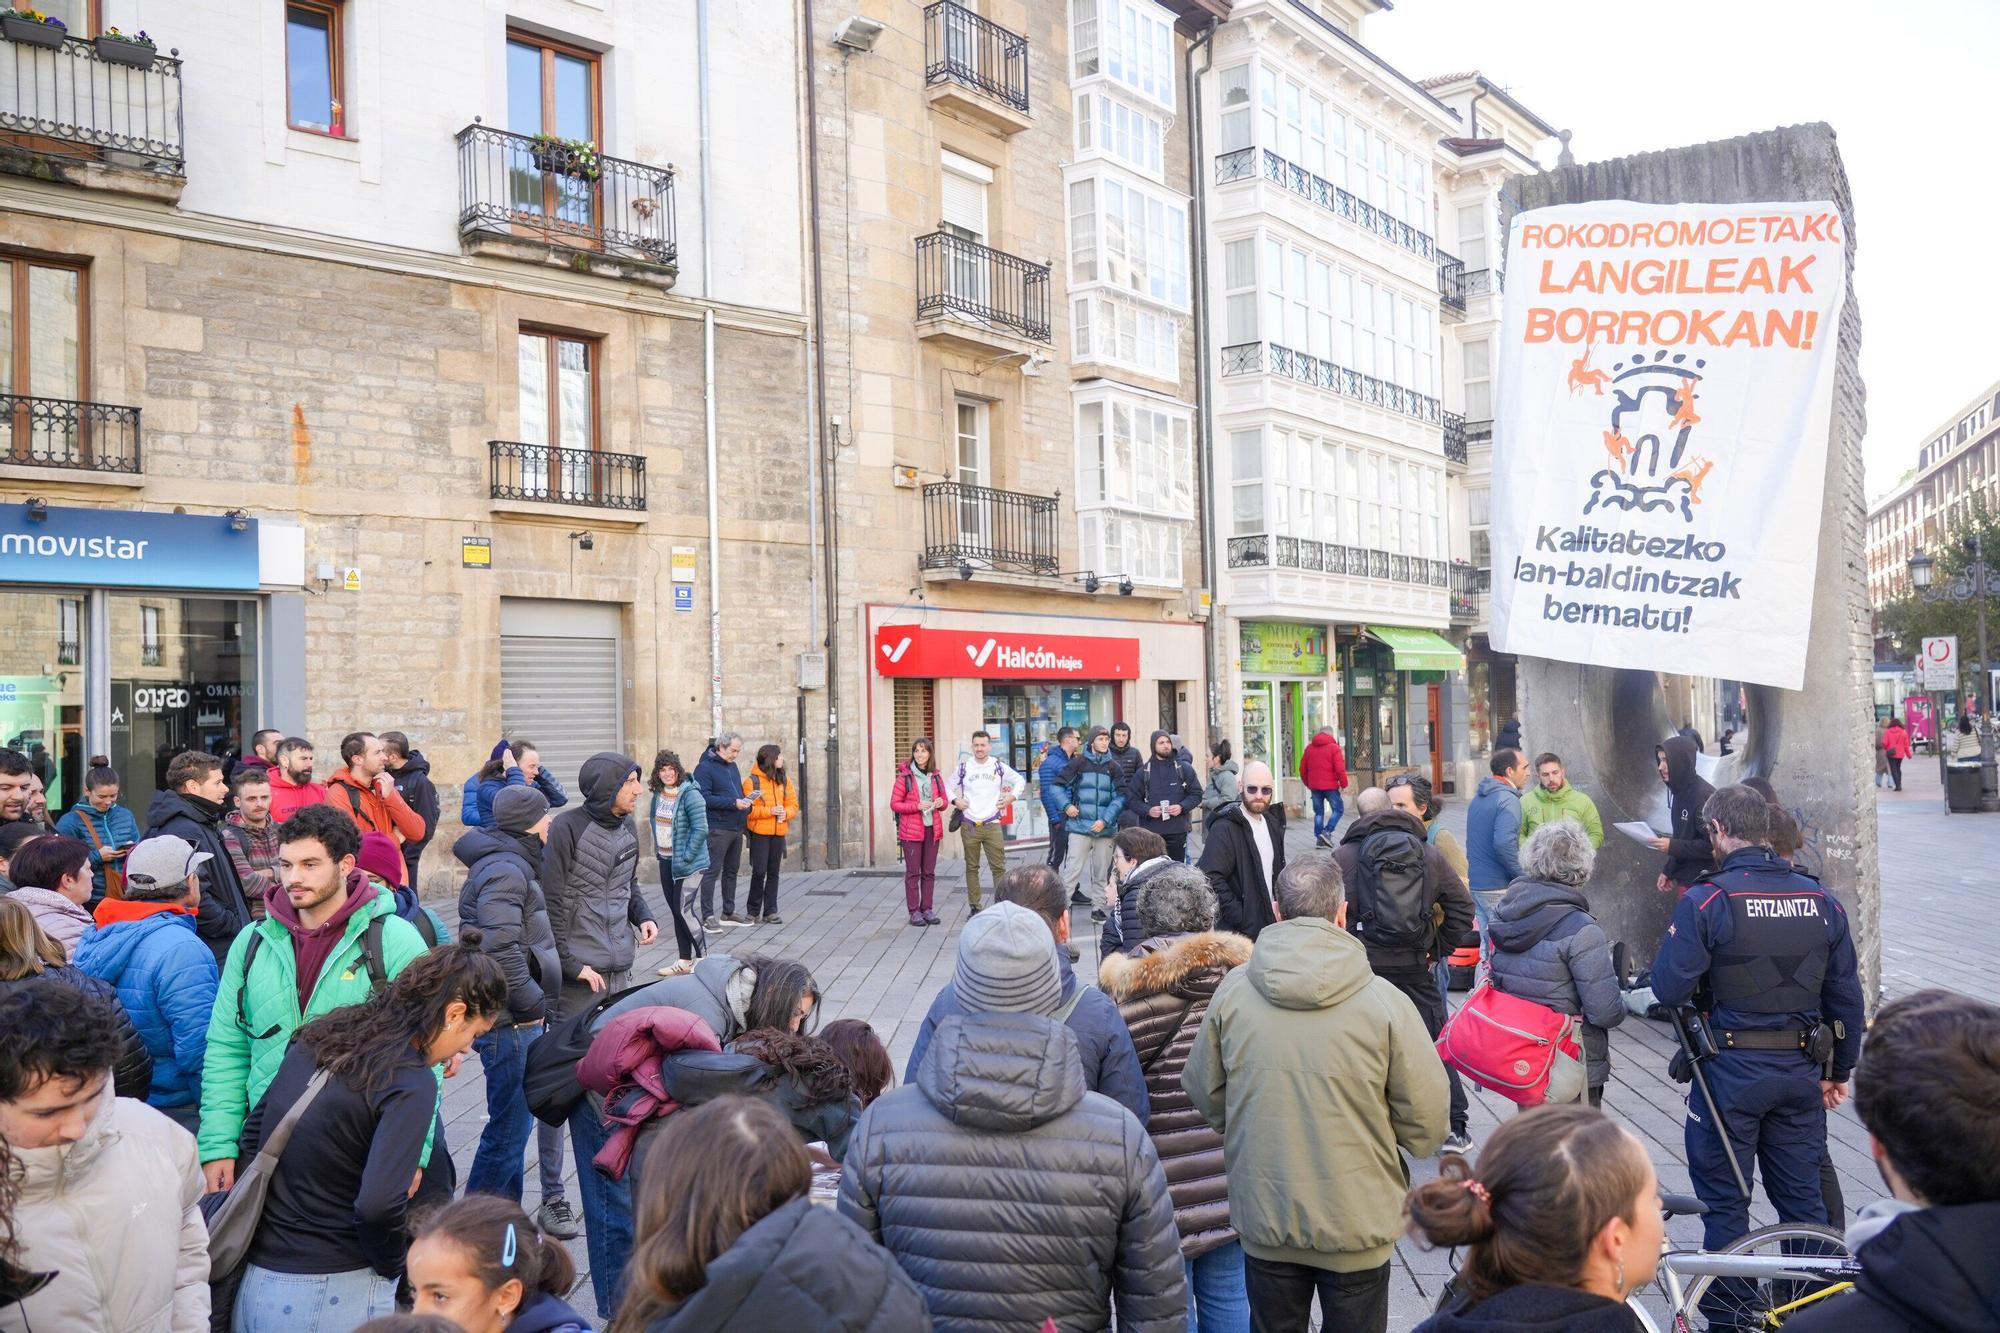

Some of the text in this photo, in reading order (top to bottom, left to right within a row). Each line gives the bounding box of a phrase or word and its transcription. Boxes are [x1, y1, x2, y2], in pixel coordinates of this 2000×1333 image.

[1539, 254, 1817, 295] LANGILEAK
[1524, 307, 1819, 350] BORROKAN!
[1, 533, 149, 560] movistar
[1535, 525, 1726, 562] Kalitatezko
[1513, 555, 1742, 600] lan-baldintzak
[1543, 593, 1693, 634] bermatu!
[997, 645, 1083, 671] Halcón viajes
[1746, 898, 1819, 917] ERTZAINTZA
